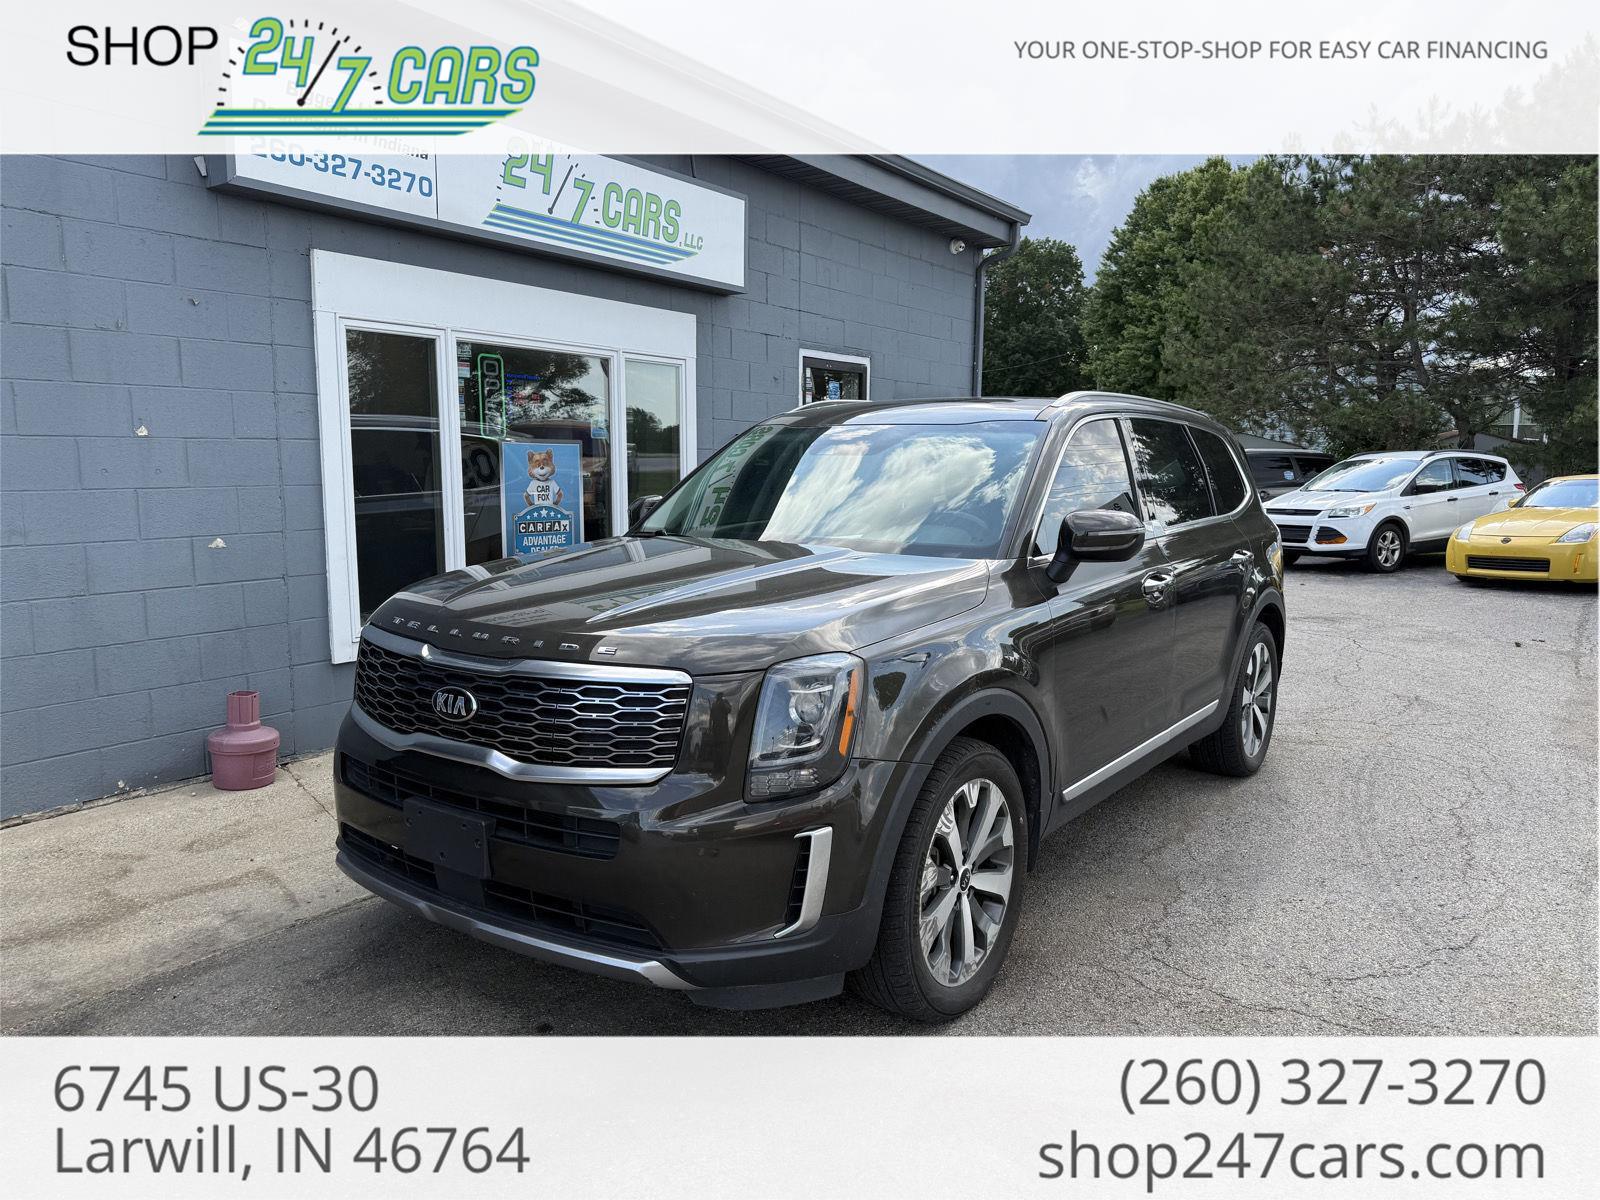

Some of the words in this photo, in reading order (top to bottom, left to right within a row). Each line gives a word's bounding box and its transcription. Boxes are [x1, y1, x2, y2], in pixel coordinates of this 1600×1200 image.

[536, 485, 550, 493] CAR
[519, 521, 569, 533] CARFAX
[523, 535, 567, 546] ADVANTAGE
[392, 616, 618, 655] TELLURIDE
[436, 692, 467, 716] KIA
